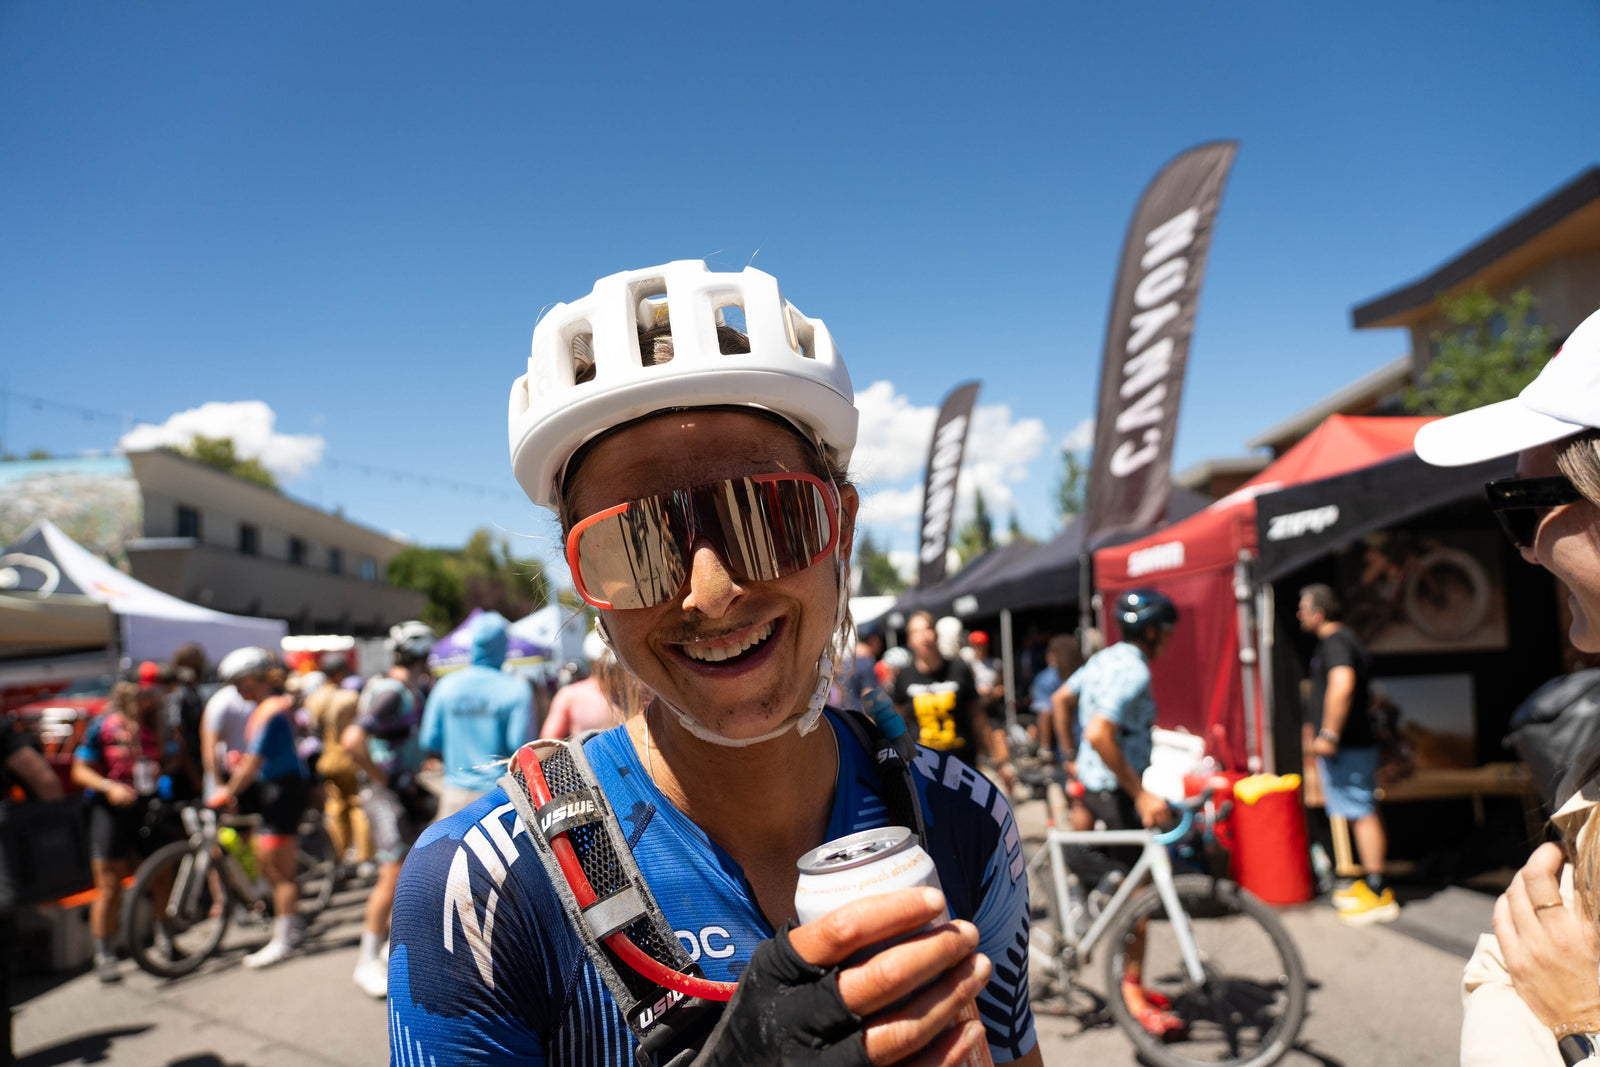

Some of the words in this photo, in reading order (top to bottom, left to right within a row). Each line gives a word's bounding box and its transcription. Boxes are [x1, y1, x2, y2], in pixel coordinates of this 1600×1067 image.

[1109, 206, 1200, 478] CANYON
[541, 800, 595, 833] USWE
[673, 925, 735, 962] OC
[640, 971, 694, 1029] USW
